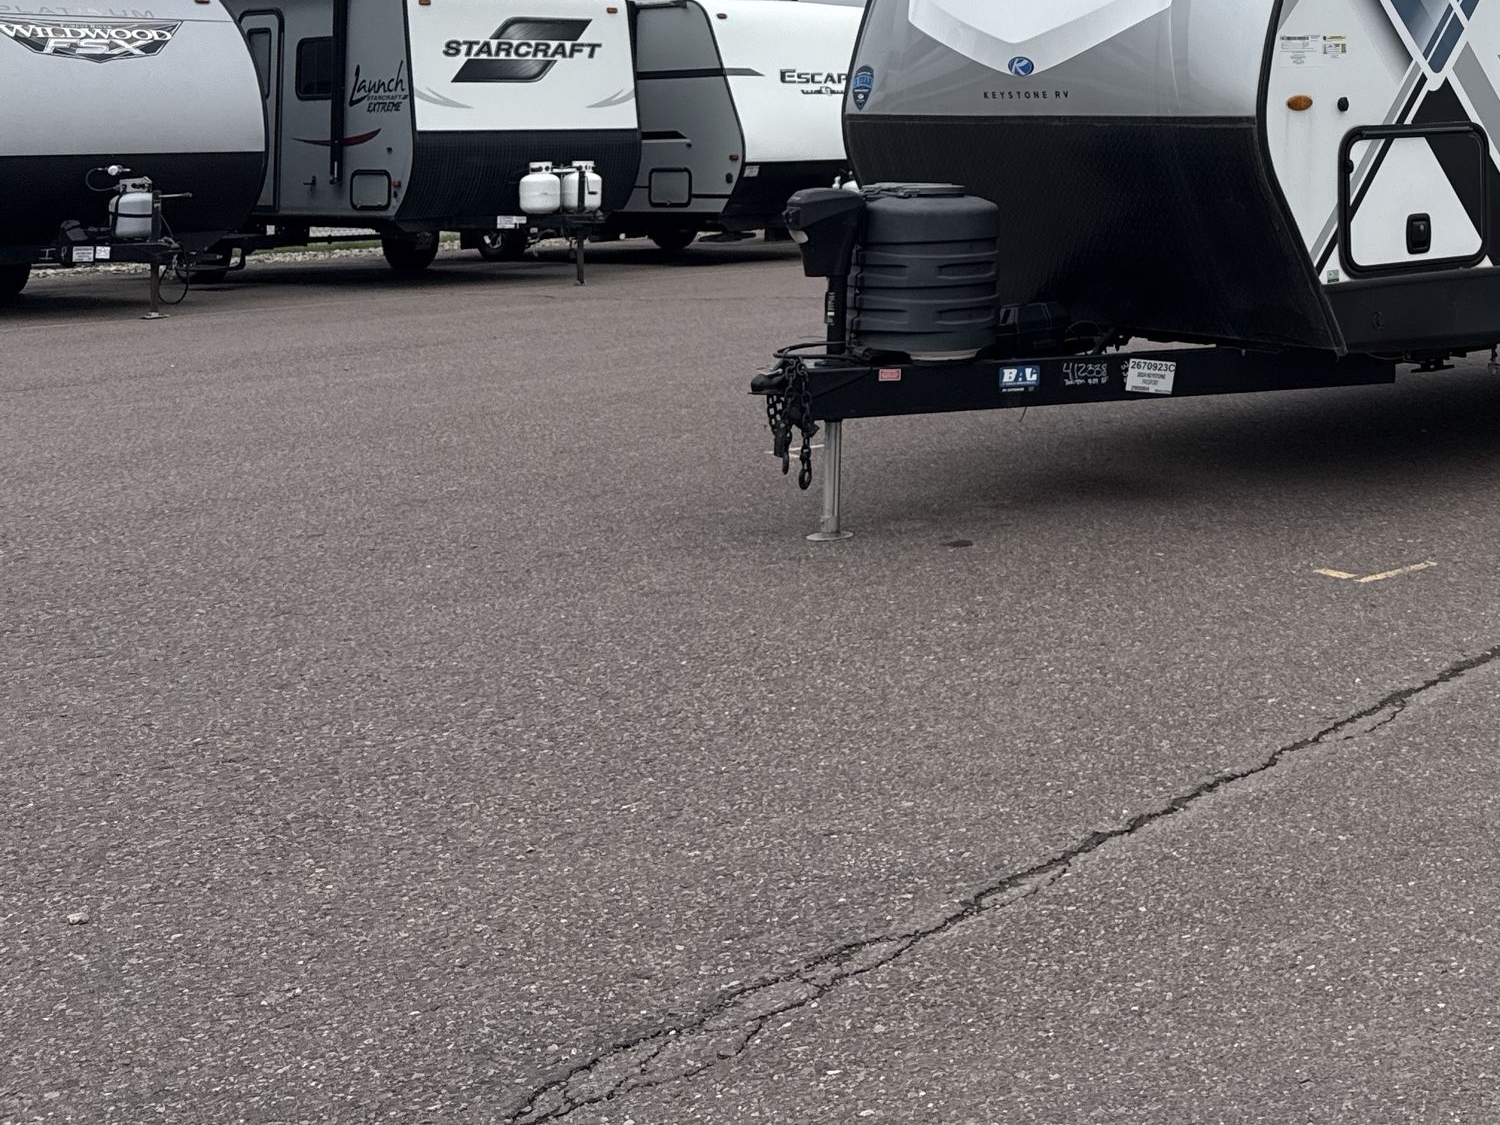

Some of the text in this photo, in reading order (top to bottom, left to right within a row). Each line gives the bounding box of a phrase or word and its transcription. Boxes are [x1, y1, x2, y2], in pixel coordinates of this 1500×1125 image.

[0, 24, 173, 41] WILDWOOD
[42, 38, 154, 56] FSX
[442, 39, 603, 59] STARCRAFT
[349, 59, 406, 107] Launch
[983, 90, 1069, 100] KEYSTONE RV
[1130, 360, 1176, 373] 2670923C
